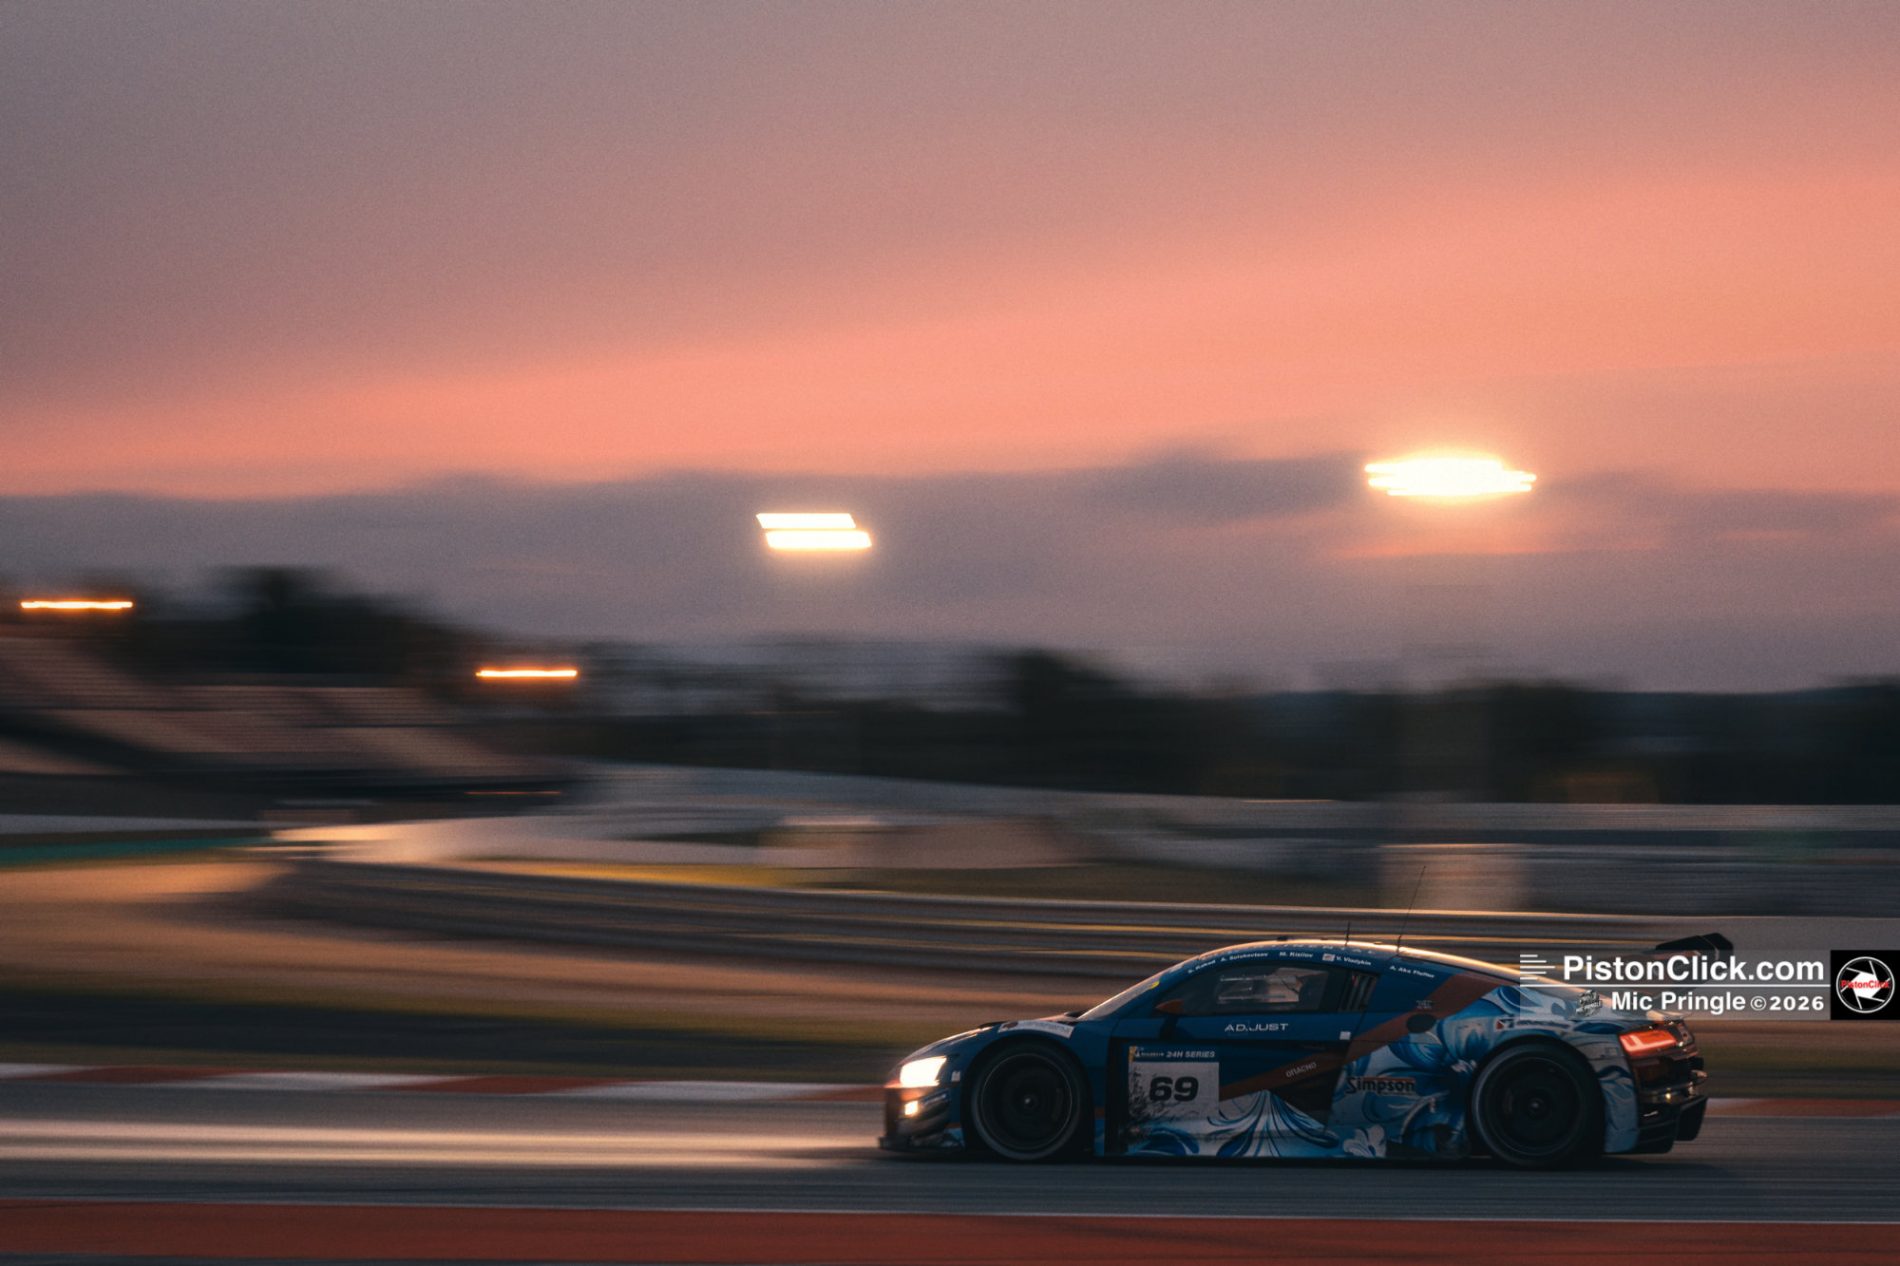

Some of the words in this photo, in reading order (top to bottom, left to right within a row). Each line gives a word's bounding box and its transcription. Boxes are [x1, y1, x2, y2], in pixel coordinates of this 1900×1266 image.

[1166, 1050, 1183, 1058] 24H
[1184, 1050, 1216, 1058] SERIES
[1150, 1077, 1199, 1101] 69
[1345, 1077, 1415, 1095] Simpson
